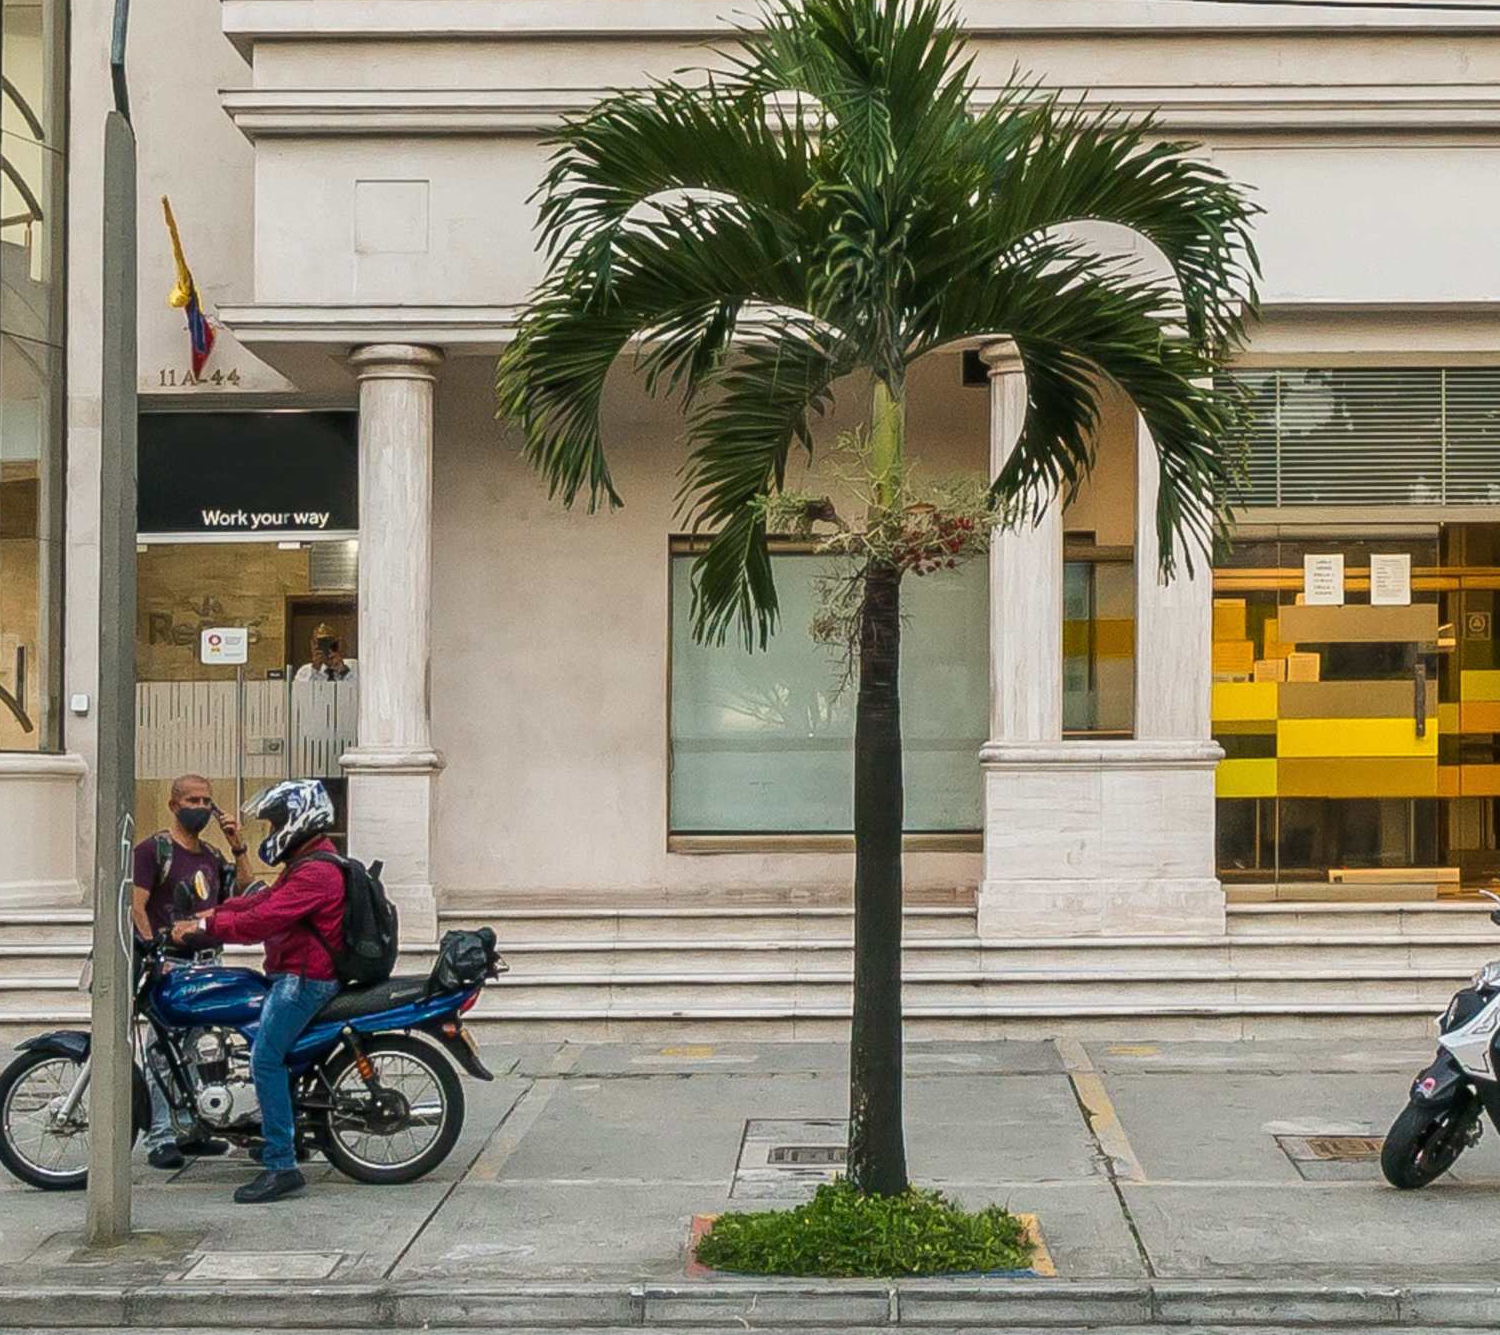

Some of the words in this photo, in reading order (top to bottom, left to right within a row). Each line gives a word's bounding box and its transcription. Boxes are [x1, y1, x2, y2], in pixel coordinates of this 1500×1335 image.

[202, 509, 248, 526] Work
[250, 512, 291, 529] your
[293, 511, 330, 529] way
